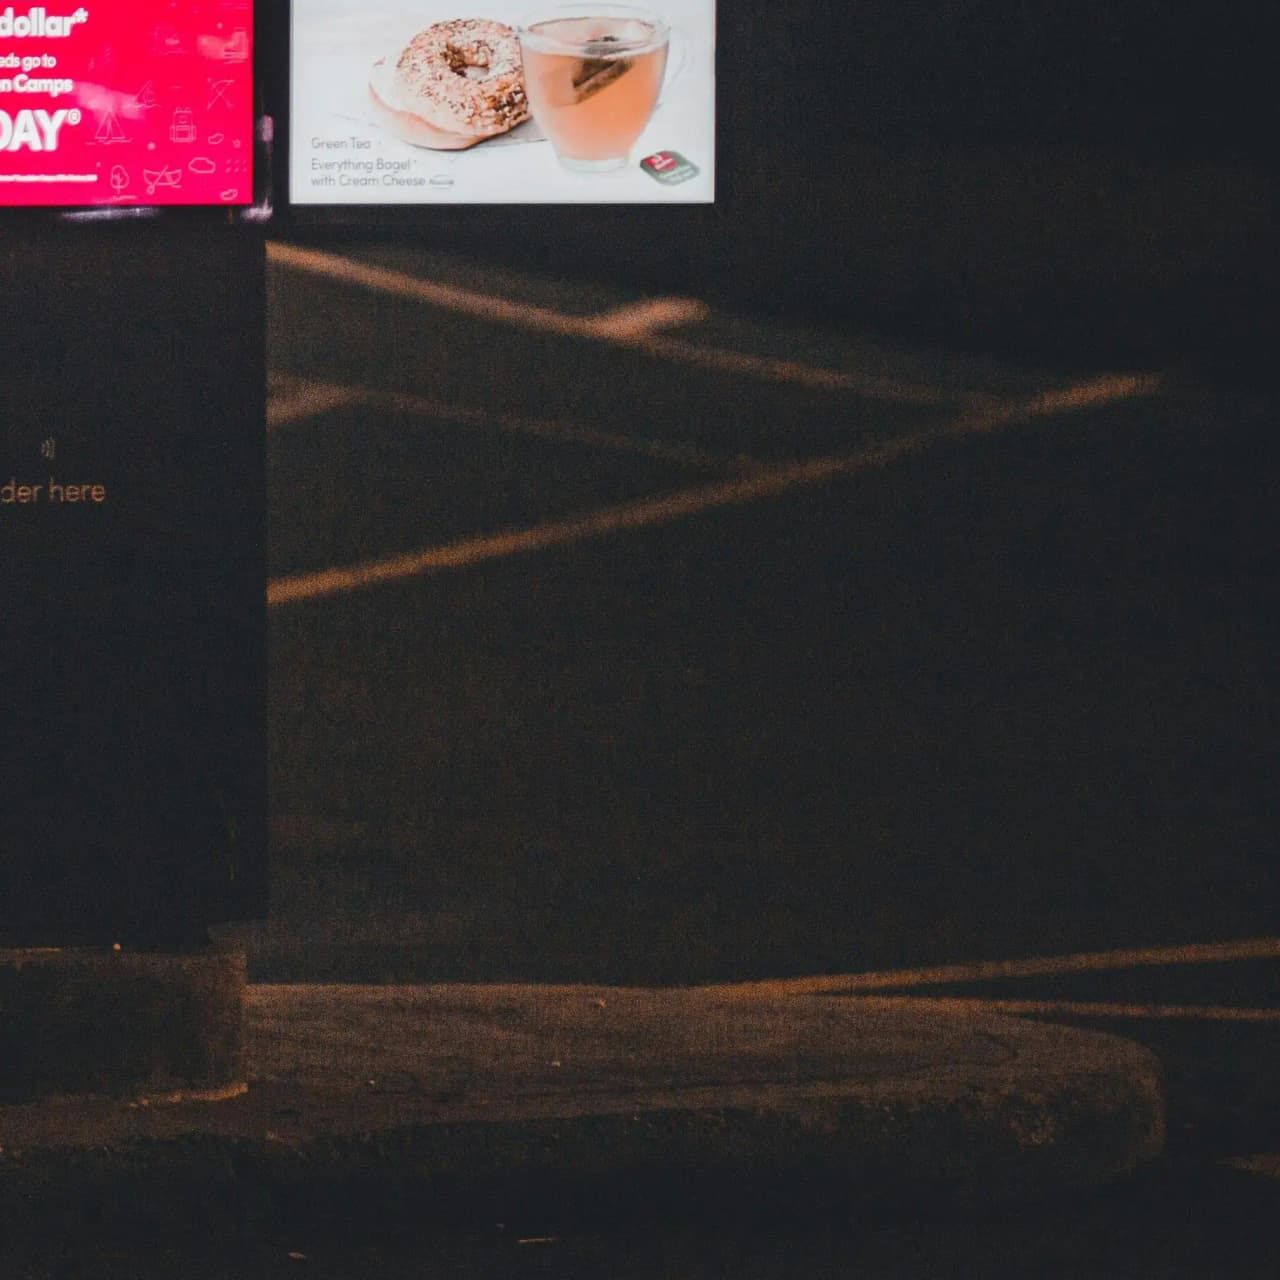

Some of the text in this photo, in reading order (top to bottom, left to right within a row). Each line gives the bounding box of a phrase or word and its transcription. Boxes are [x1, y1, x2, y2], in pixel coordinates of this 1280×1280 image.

[22, 57, 40, 72] go
[41, 54, 56, 68] to
[13, 74, 73, 97] Camps
[311, 137, 371, 149] Green Tea
[311, 159, 410, 173] Everything Bagel
[311, 175, 426, 187] with Cream Cheese
[49, 478, 105, 503] here
